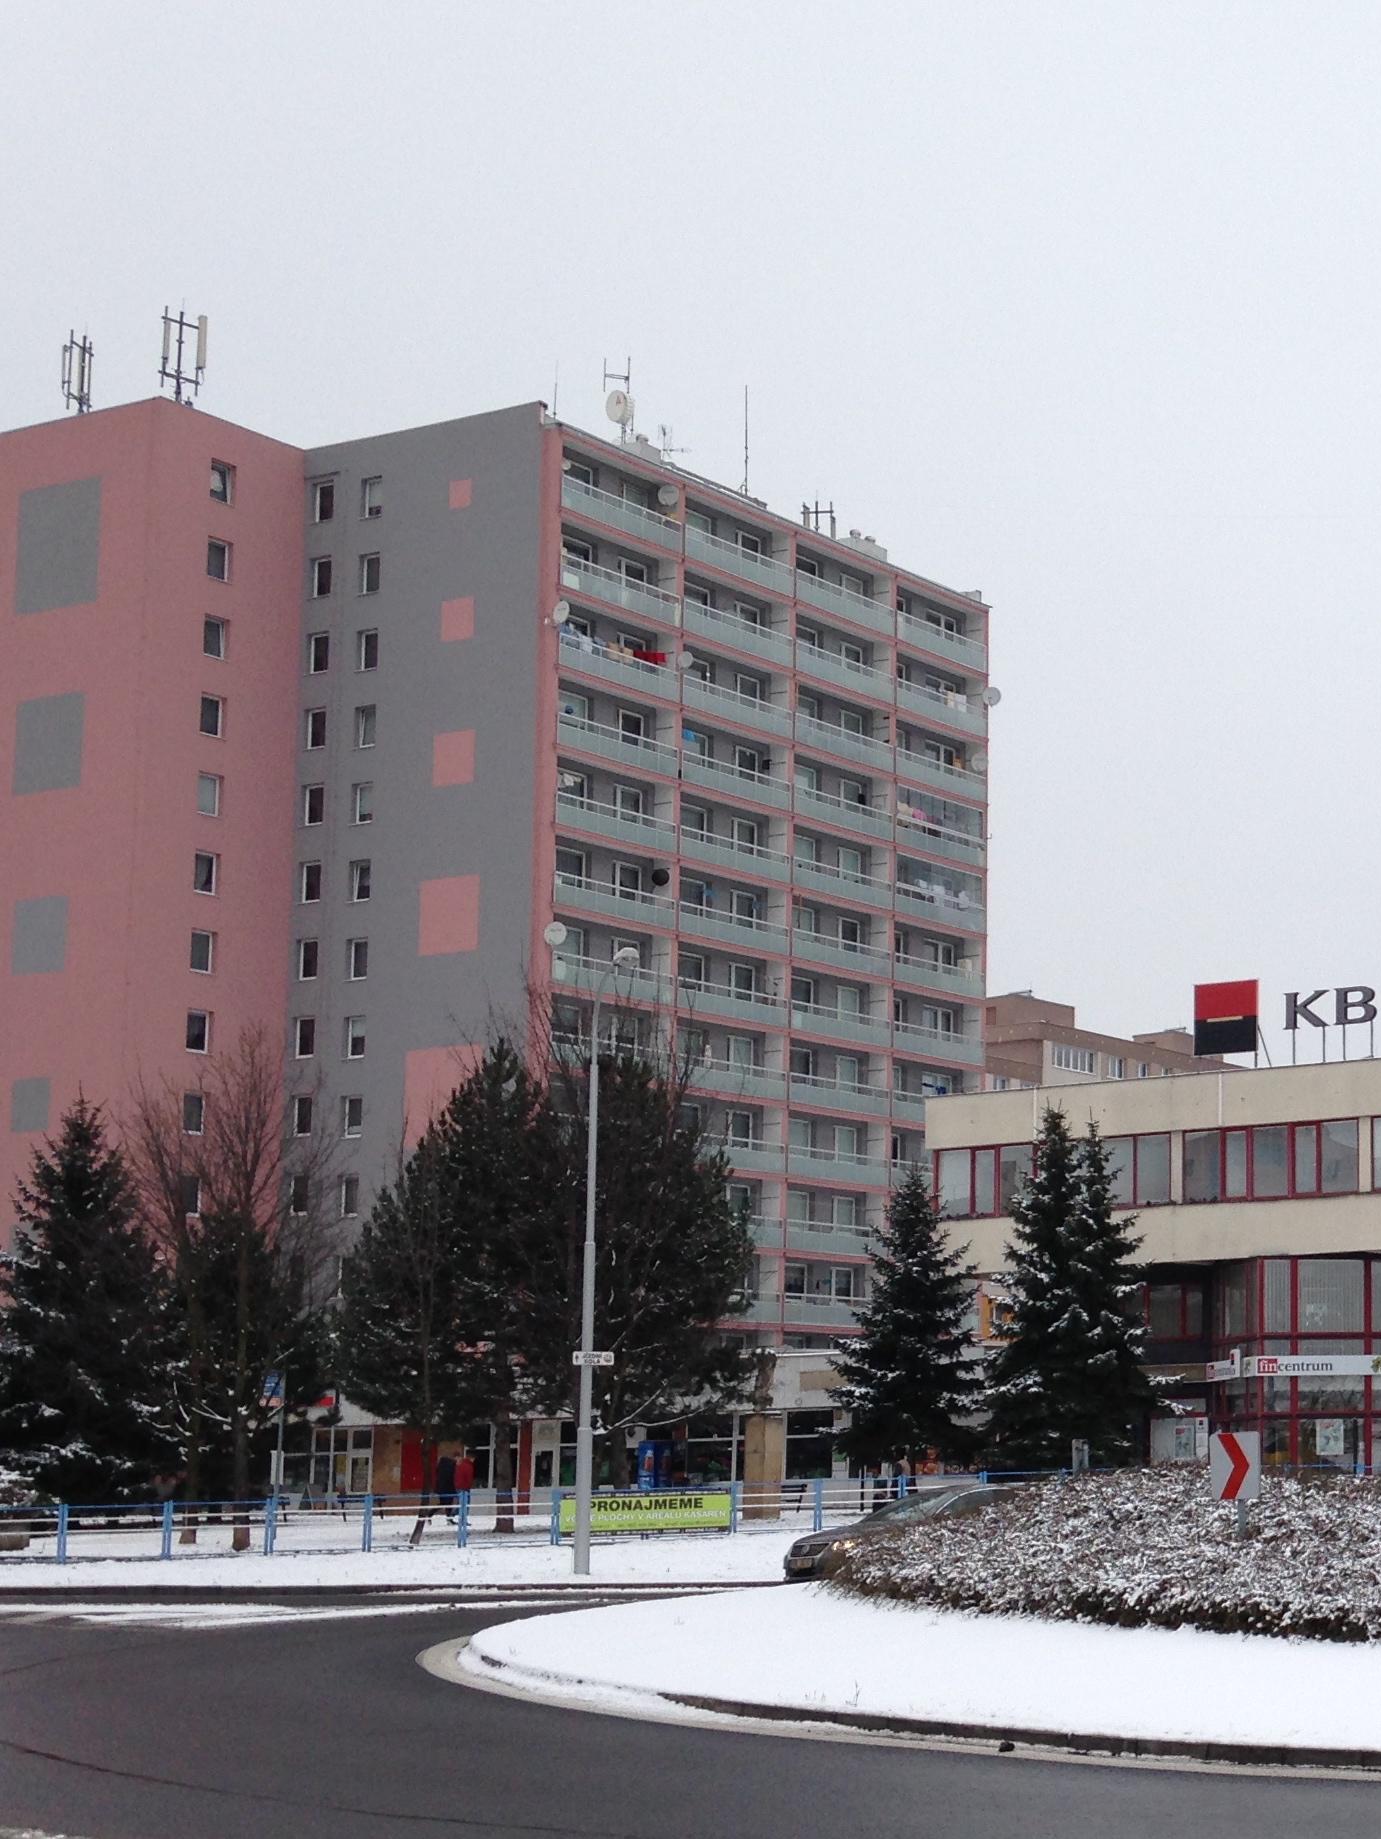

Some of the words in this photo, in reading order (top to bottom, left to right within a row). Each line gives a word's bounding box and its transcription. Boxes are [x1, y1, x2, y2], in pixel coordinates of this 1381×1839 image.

[1283, 986, 1378, 1030] KB
[1258, 1359, 1333, 1373] fincentrum
[598, 1512, 634, 1521] PLOCHY
